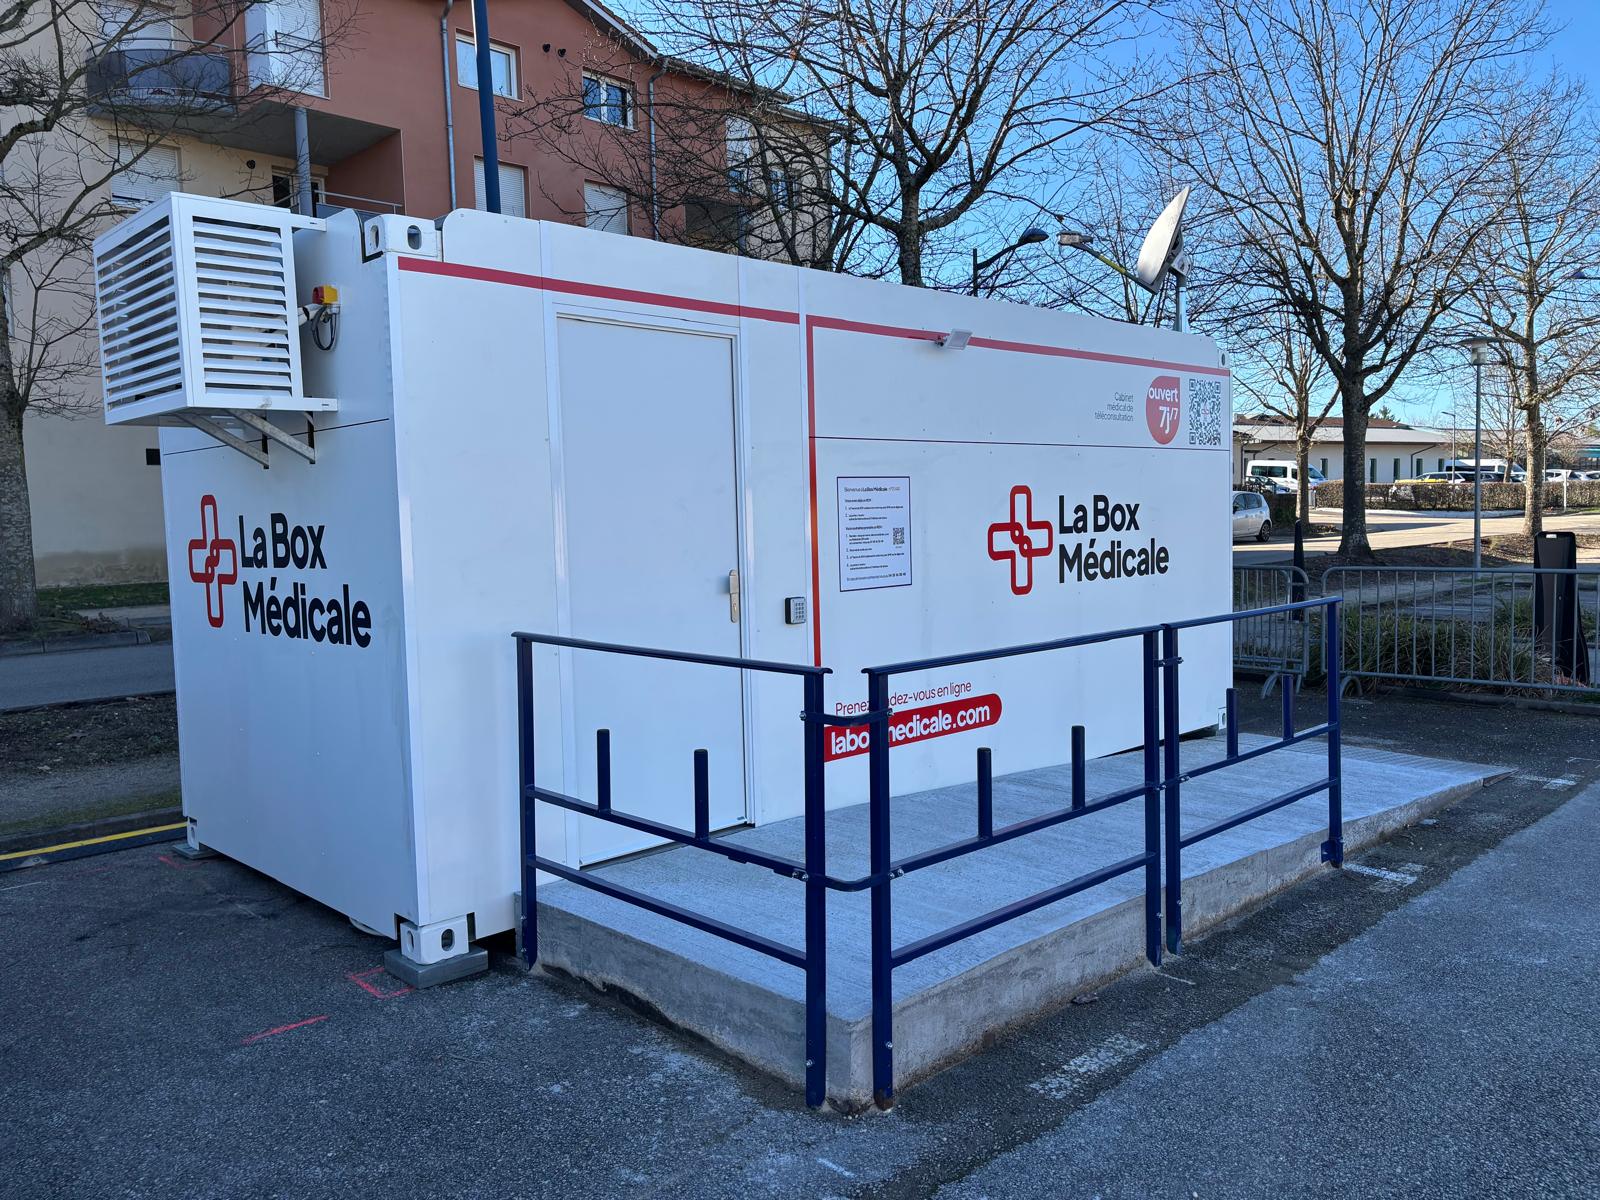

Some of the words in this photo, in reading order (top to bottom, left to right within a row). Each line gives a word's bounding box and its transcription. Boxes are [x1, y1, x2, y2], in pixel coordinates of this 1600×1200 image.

[1114, 391, 1134, 403] Cabinet
[1148, 387, 1179, 403] ouvert
[1094, 411, 1134, 422] téléconsultation
[1158, 405, 1179, 434] 7j/7
[1058, 494, 1088, 535] La
[1093, 494, 1140, 532] Box
[238, 514, 268, 569] La
[270, 512, 328, 570] Box
[1058, 537, 1170, 584] Médicale
[242, 576, 372, 649] Médicale
[937, 685, 949, 698] en
[949, 681, 972, 698] ligne
